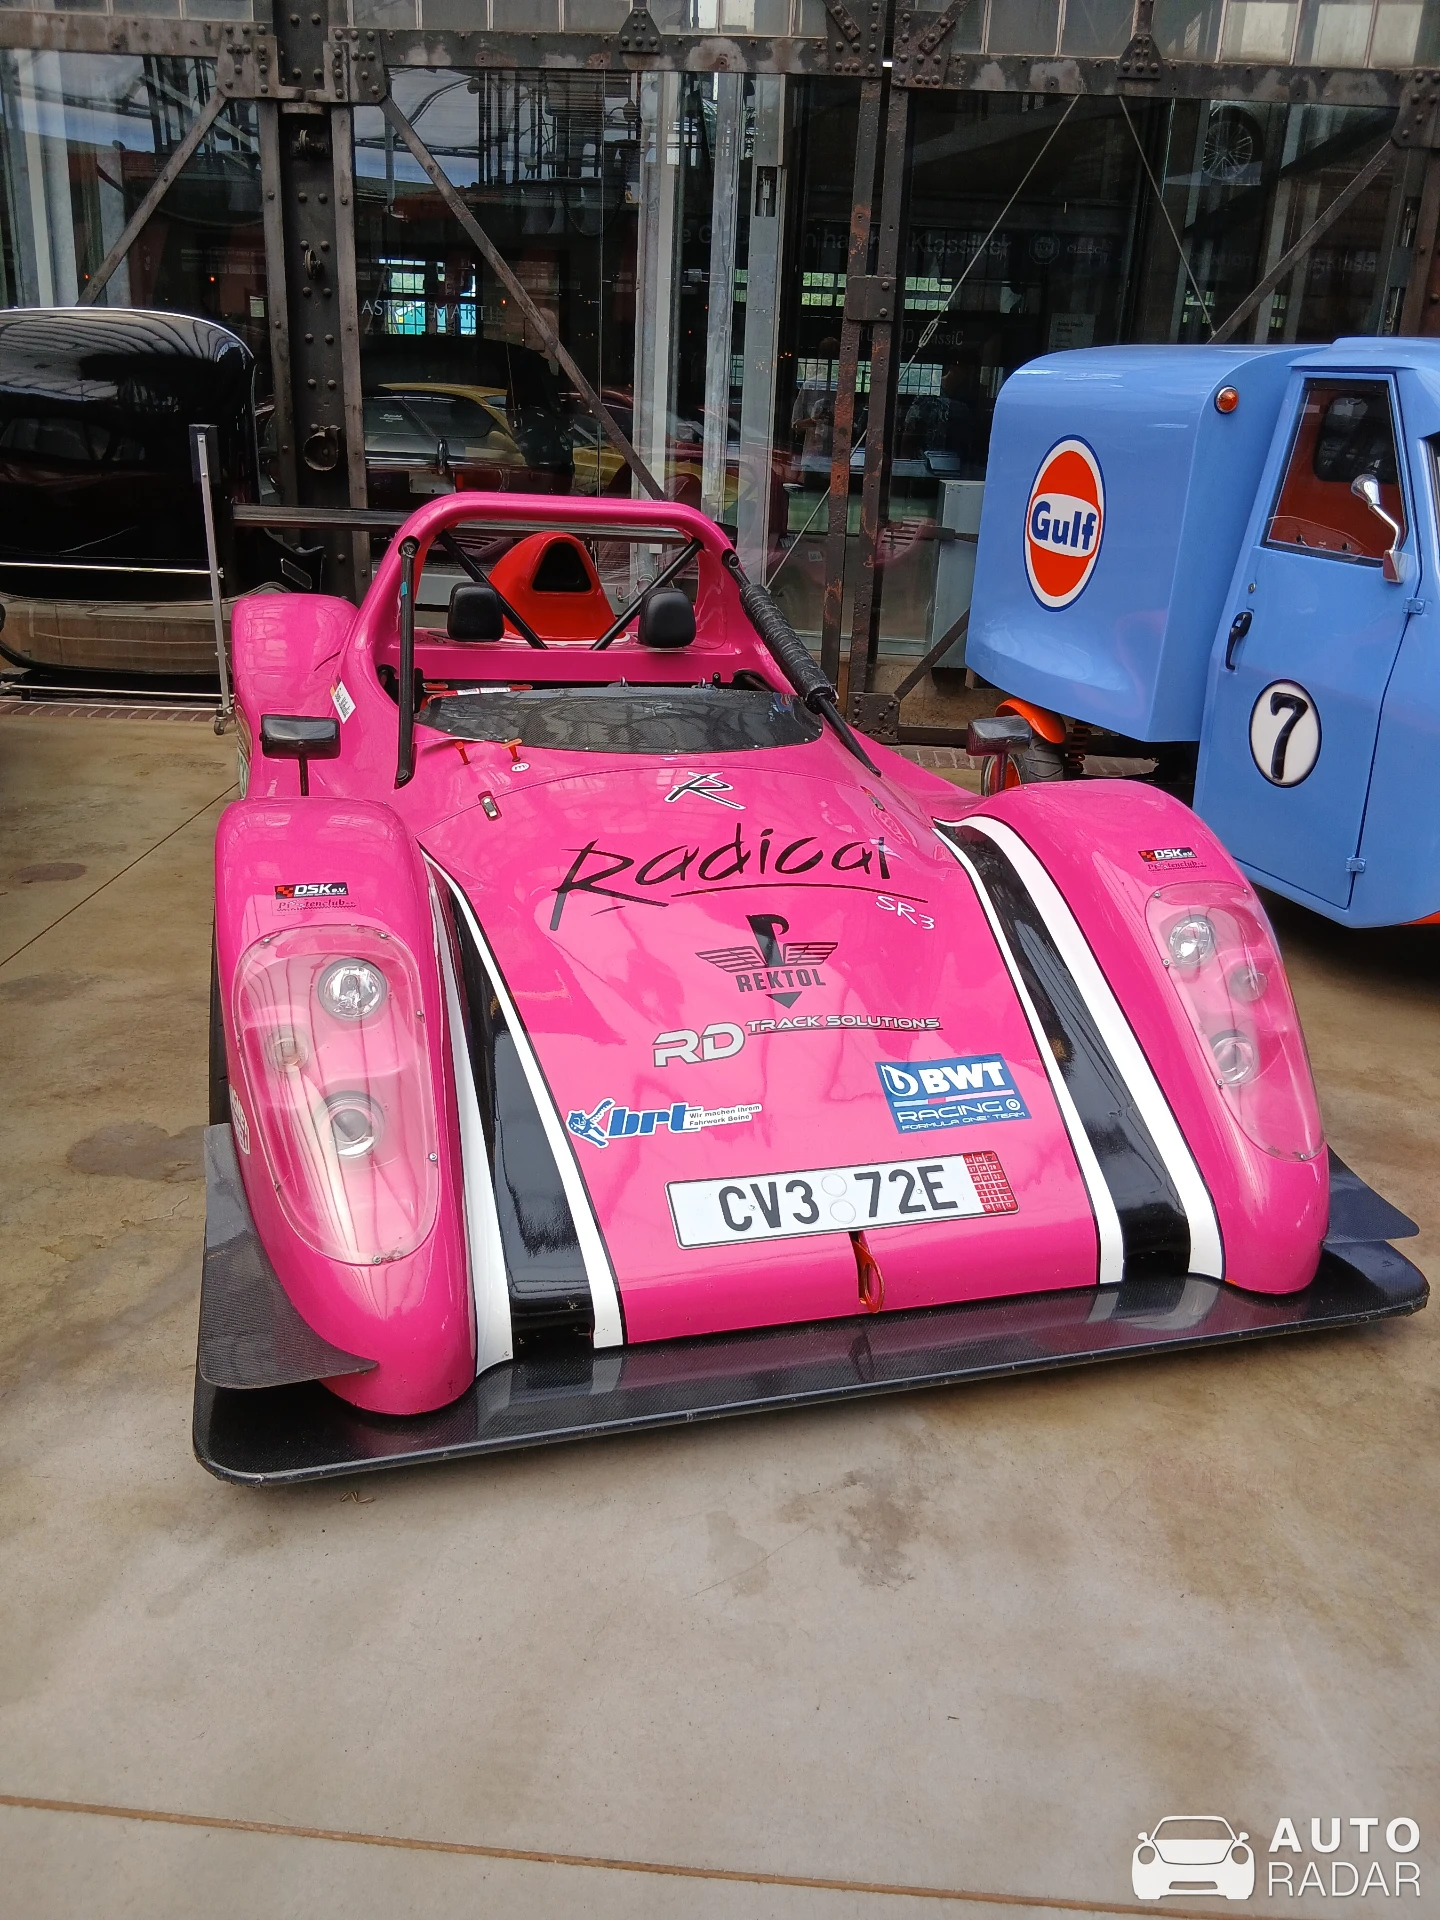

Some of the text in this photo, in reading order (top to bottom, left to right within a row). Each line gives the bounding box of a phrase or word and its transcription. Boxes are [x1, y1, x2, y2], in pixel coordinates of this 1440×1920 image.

[361, 299, 424, 318] ASTON
[1031, 501, 1097, 551] Gulf
[1269, 692, 1309, 780] 7
[1154, 849, 1183, 858] DSK
[549, 822, 890, 931] Radical
[294, 883, 333, 895] DSK
[736, 968, 826, 992] REKTOL
[652, 1014, 941, 1067] RD TRACK SOLUTIONS
[918, 1062, 1005, 1094] BWT
[609, 1104, 686, 1136] brt
[689, 1113, 750, 1127] Fahrwerk Beine
[704, 1108, 736, 1118] machen
[737, 1104, 760, 1113] Ihrem
[897, 1101, 1003, 1123] RACING
[902, 1119, 960, 1131] FORMULA
[992, 1111, 1026, 1119] TEAM
[718, 1164, 959, 1232] CV3 72E
